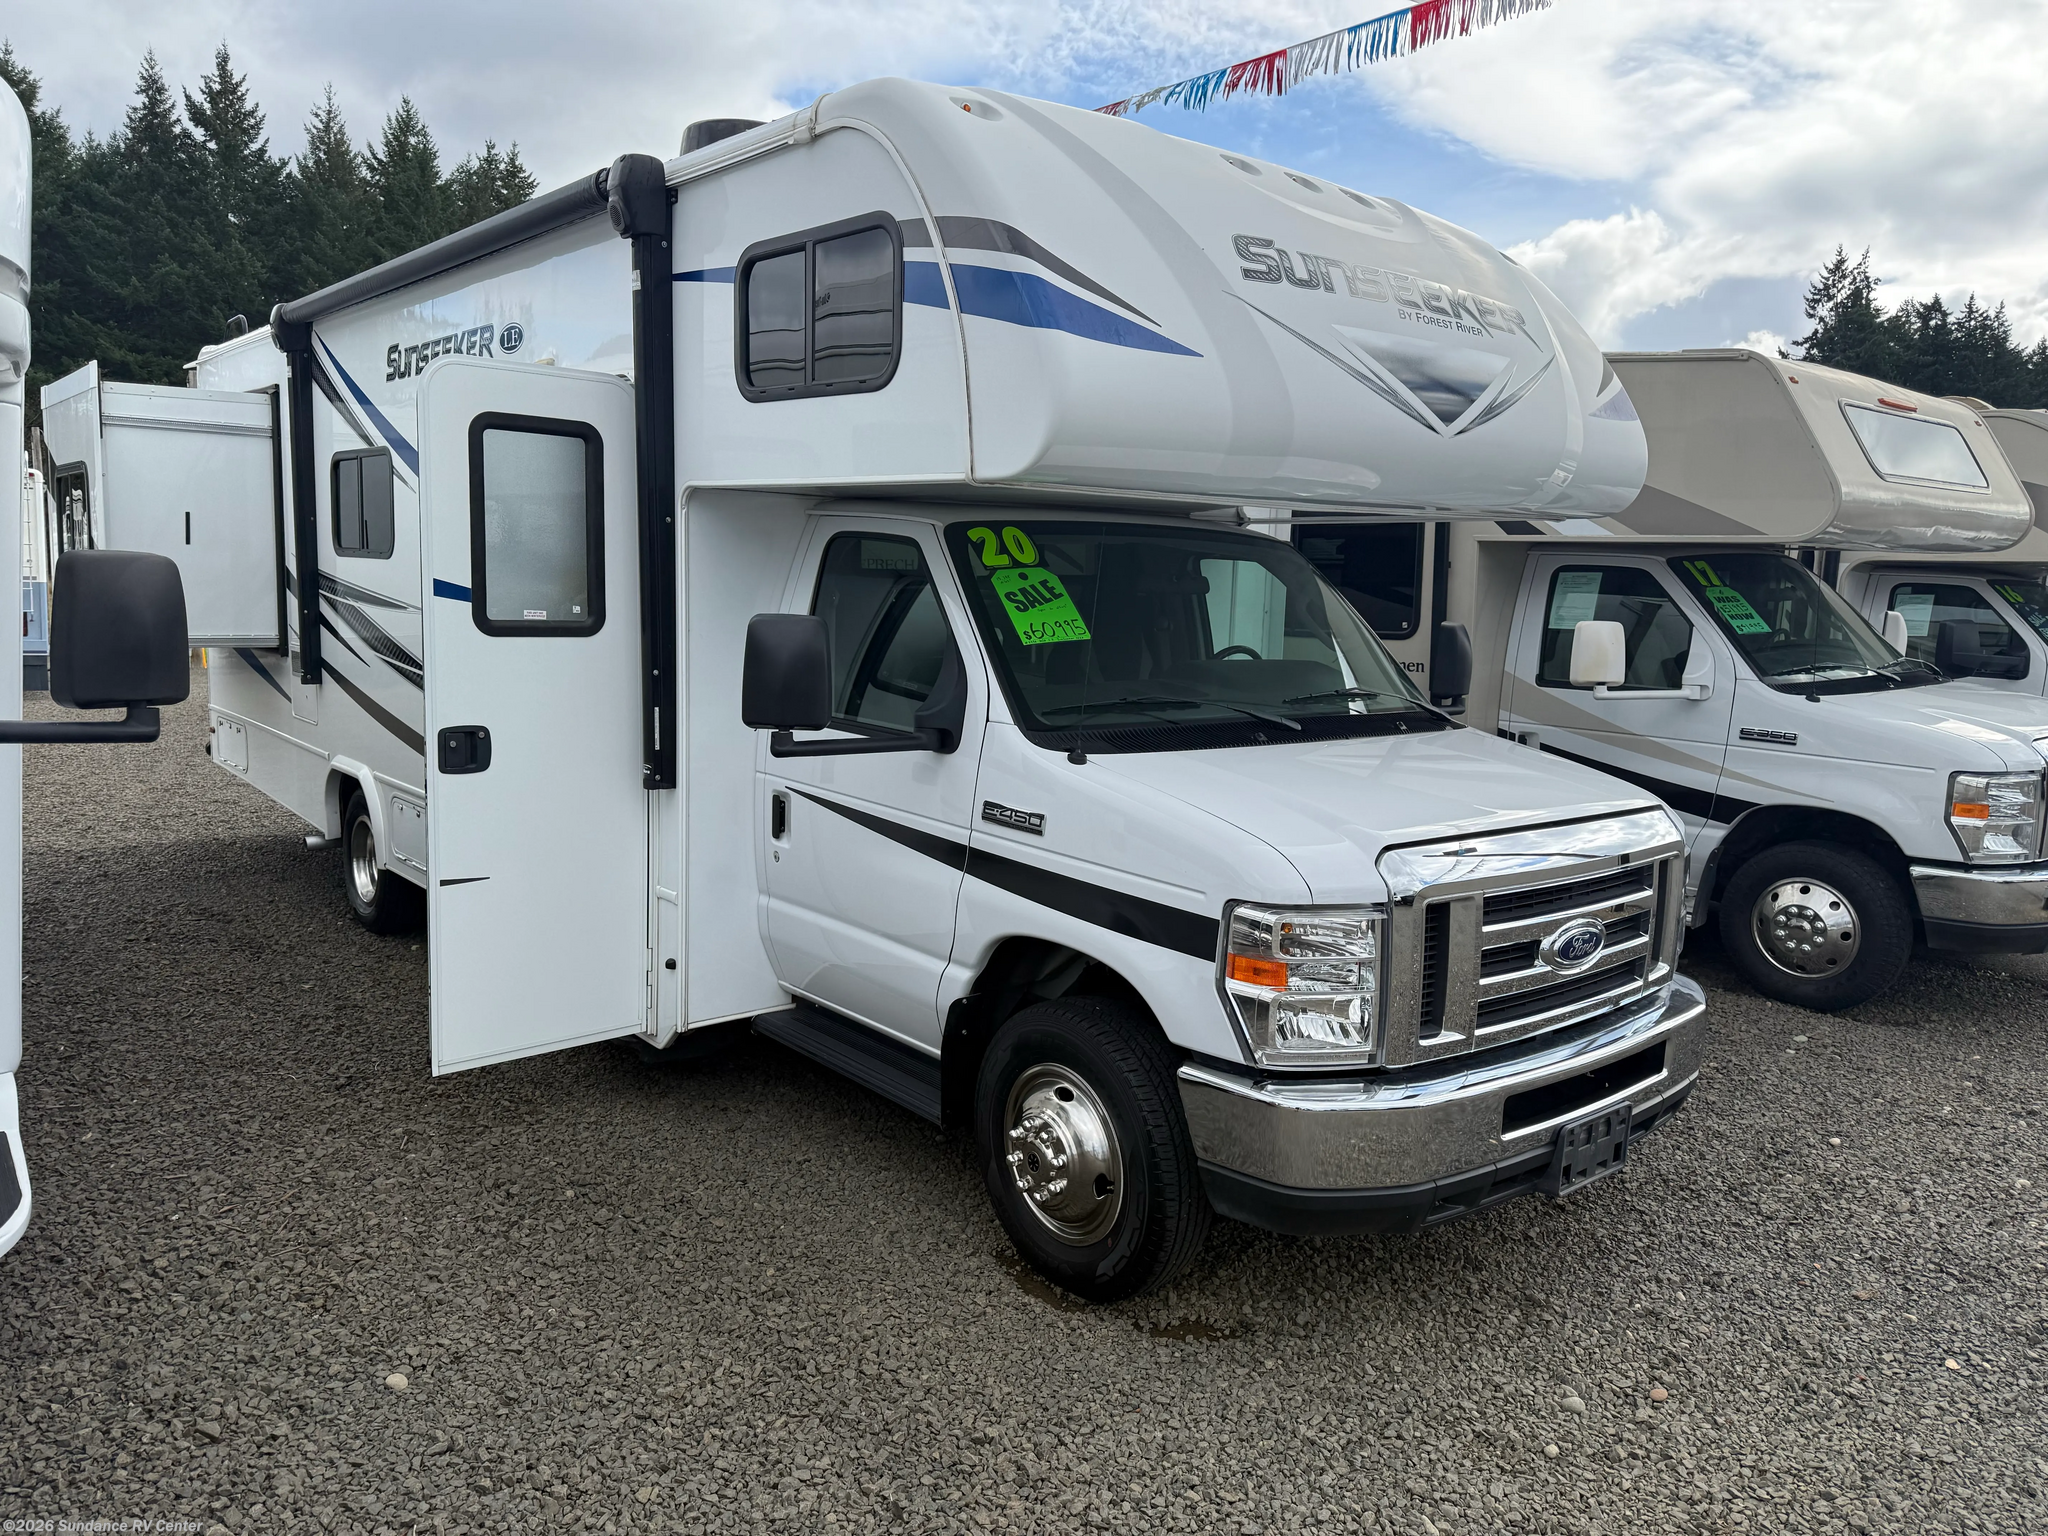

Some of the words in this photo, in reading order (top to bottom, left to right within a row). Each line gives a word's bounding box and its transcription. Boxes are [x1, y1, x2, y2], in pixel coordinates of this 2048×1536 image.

[966, 526, 1038, 569] 20
[1682, 560, 1724, 588] 17
[1003, 578, 1065, 613] SALE
[1713, 595, 1741, 604] WAS
[1994, 584, 2026, 604] 16
[1726, 612, 1755, 621] NOW
[1568, 932, 1597, 958] Ford
